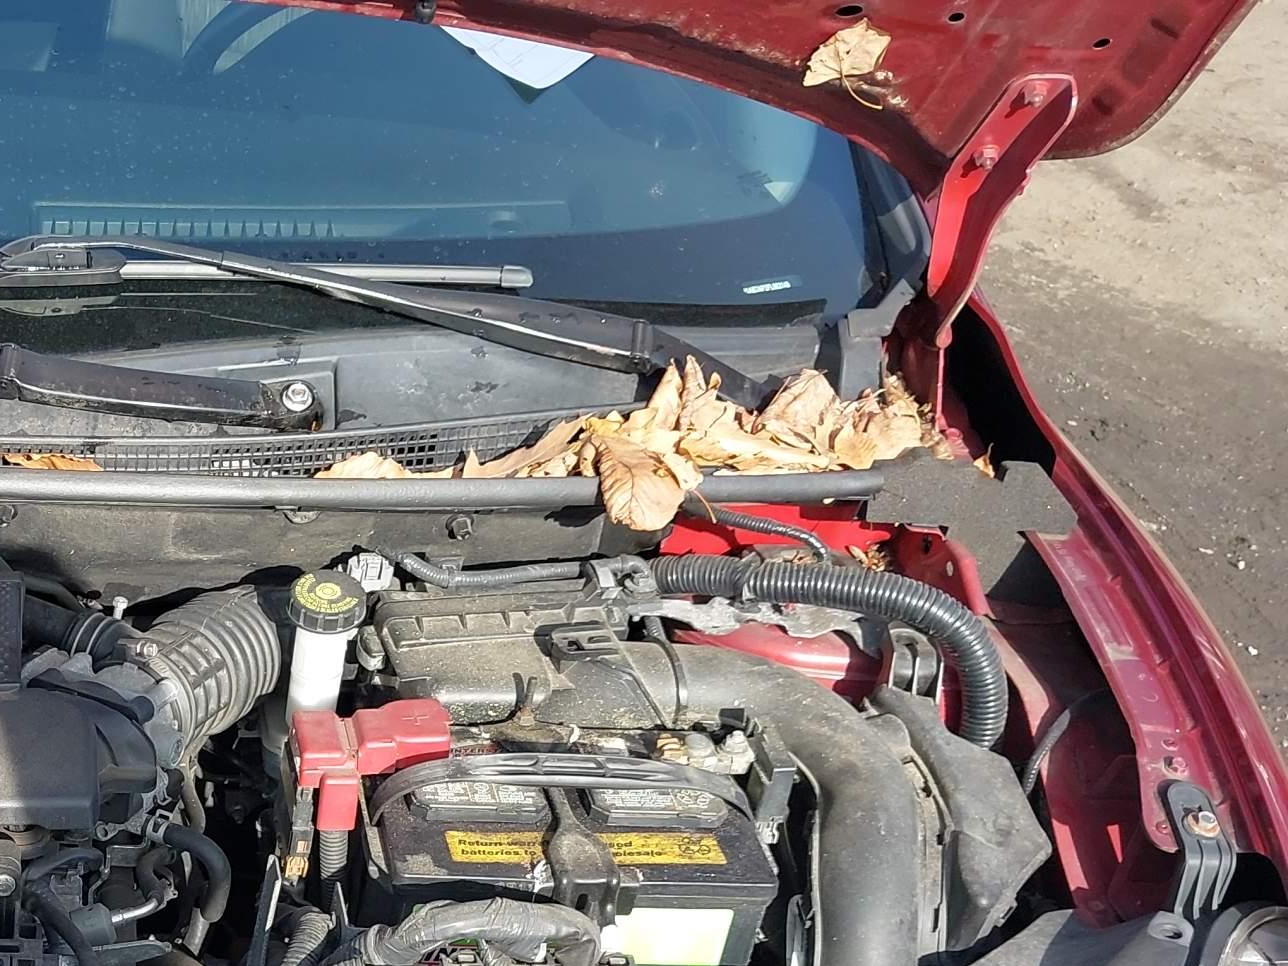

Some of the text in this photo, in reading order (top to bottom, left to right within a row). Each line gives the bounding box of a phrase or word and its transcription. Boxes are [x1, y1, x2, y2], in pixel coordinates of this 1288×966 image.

[458, 839, 502, 847] Return
[461, 848, 519, 856] batteries
[524, 848, 537, 857] to
